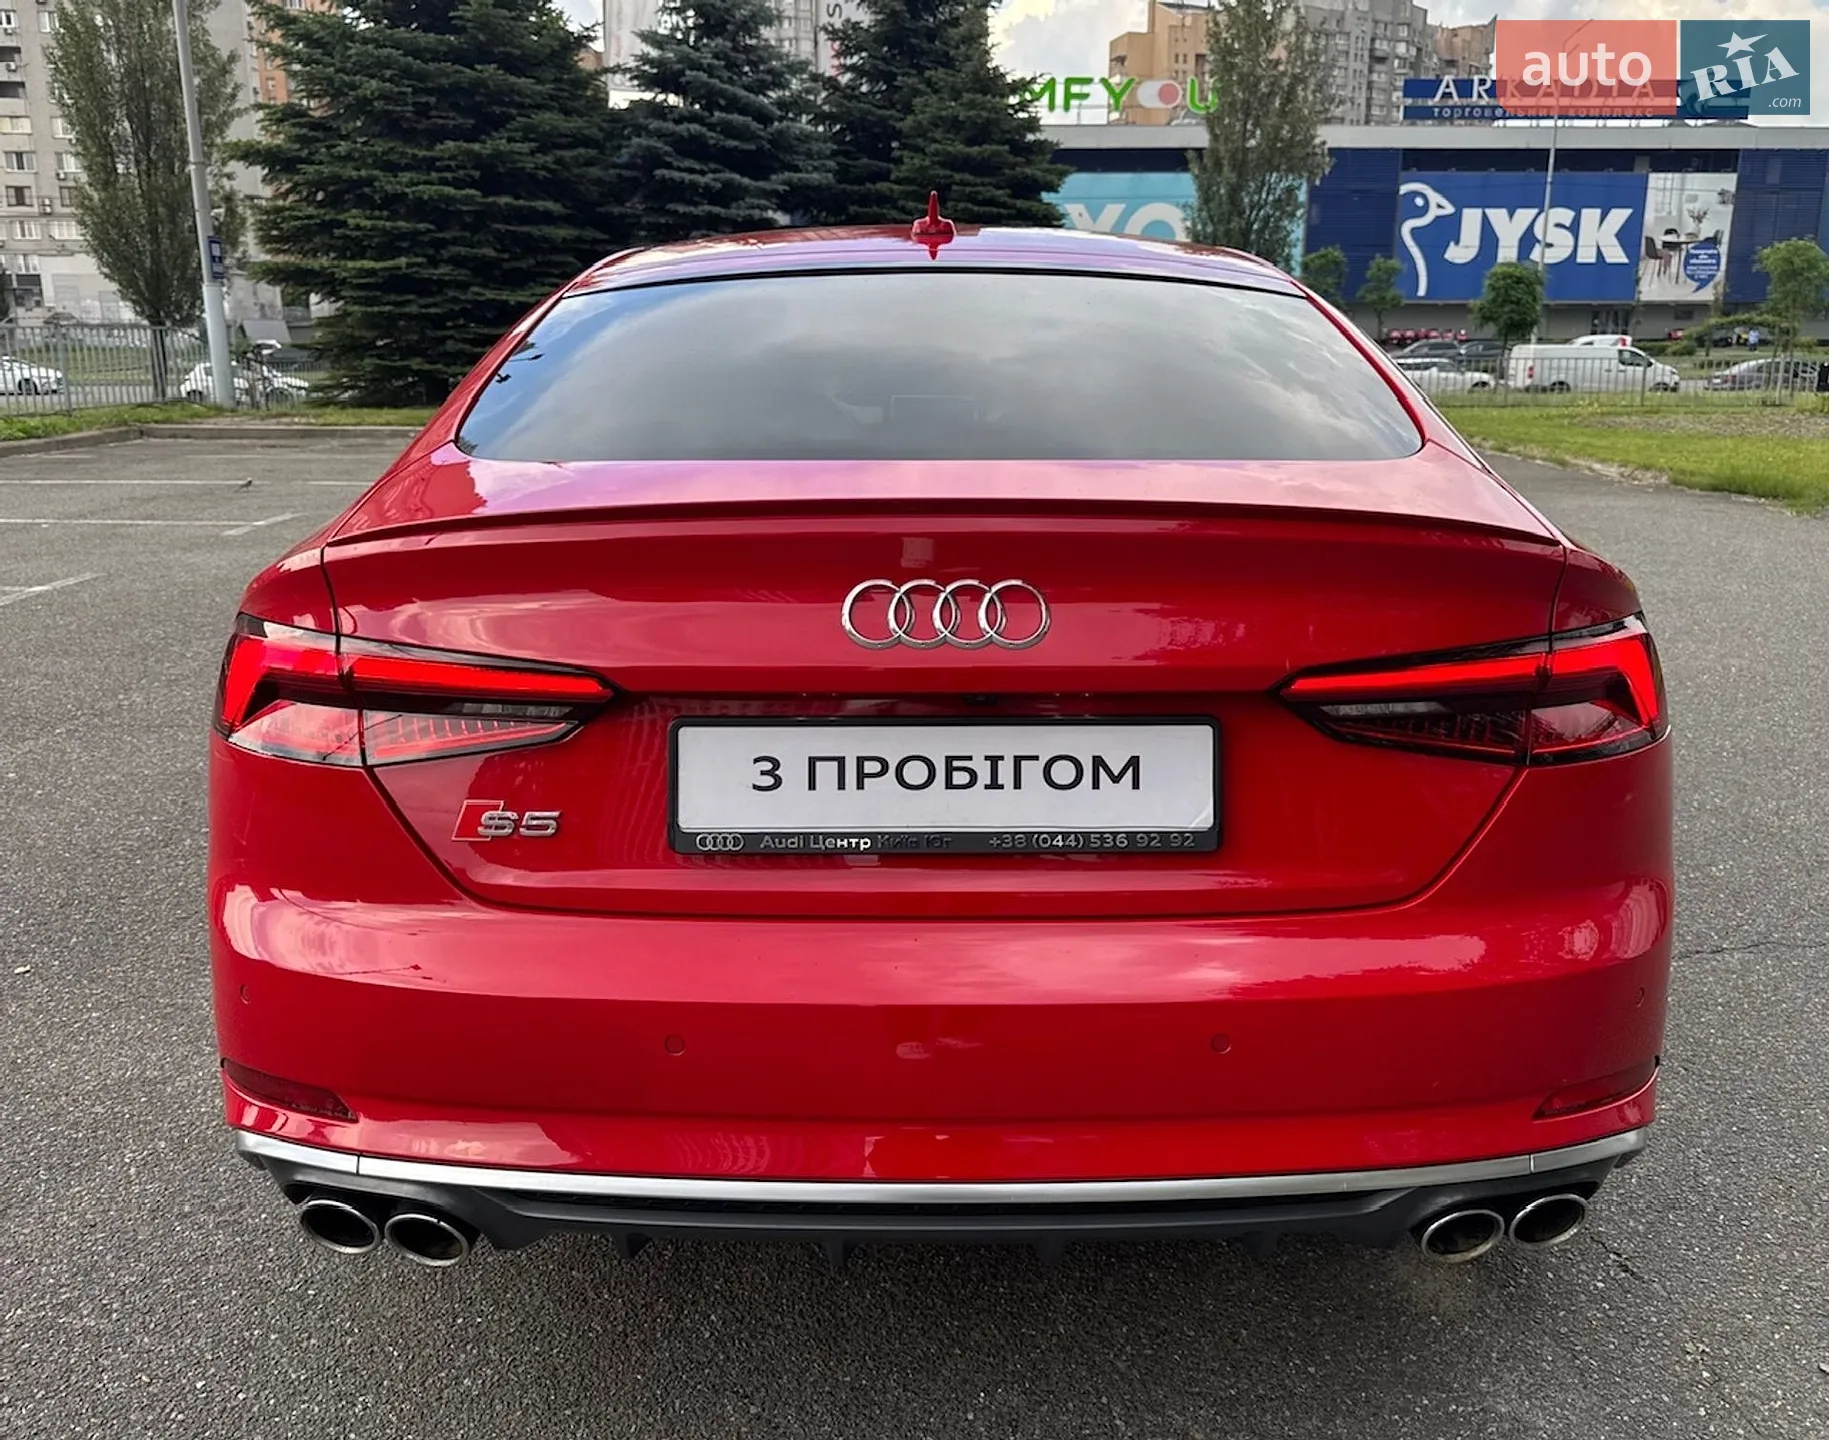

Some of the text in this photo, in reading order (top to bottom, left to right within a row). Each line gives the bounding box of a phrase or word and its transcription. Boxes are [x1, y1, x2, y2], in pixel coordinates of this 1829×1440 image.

[1443, 207, 1634, 264] JYSK
[806, 755, 1142, 791] ПРОБІГОМ
[477, 810, 562, 837] S5
[759, 834, 804, 849] Audi
[809, 834, 873, 850] Центр
[988, 833, 1196, 850] +38 (044) 536 92 92
